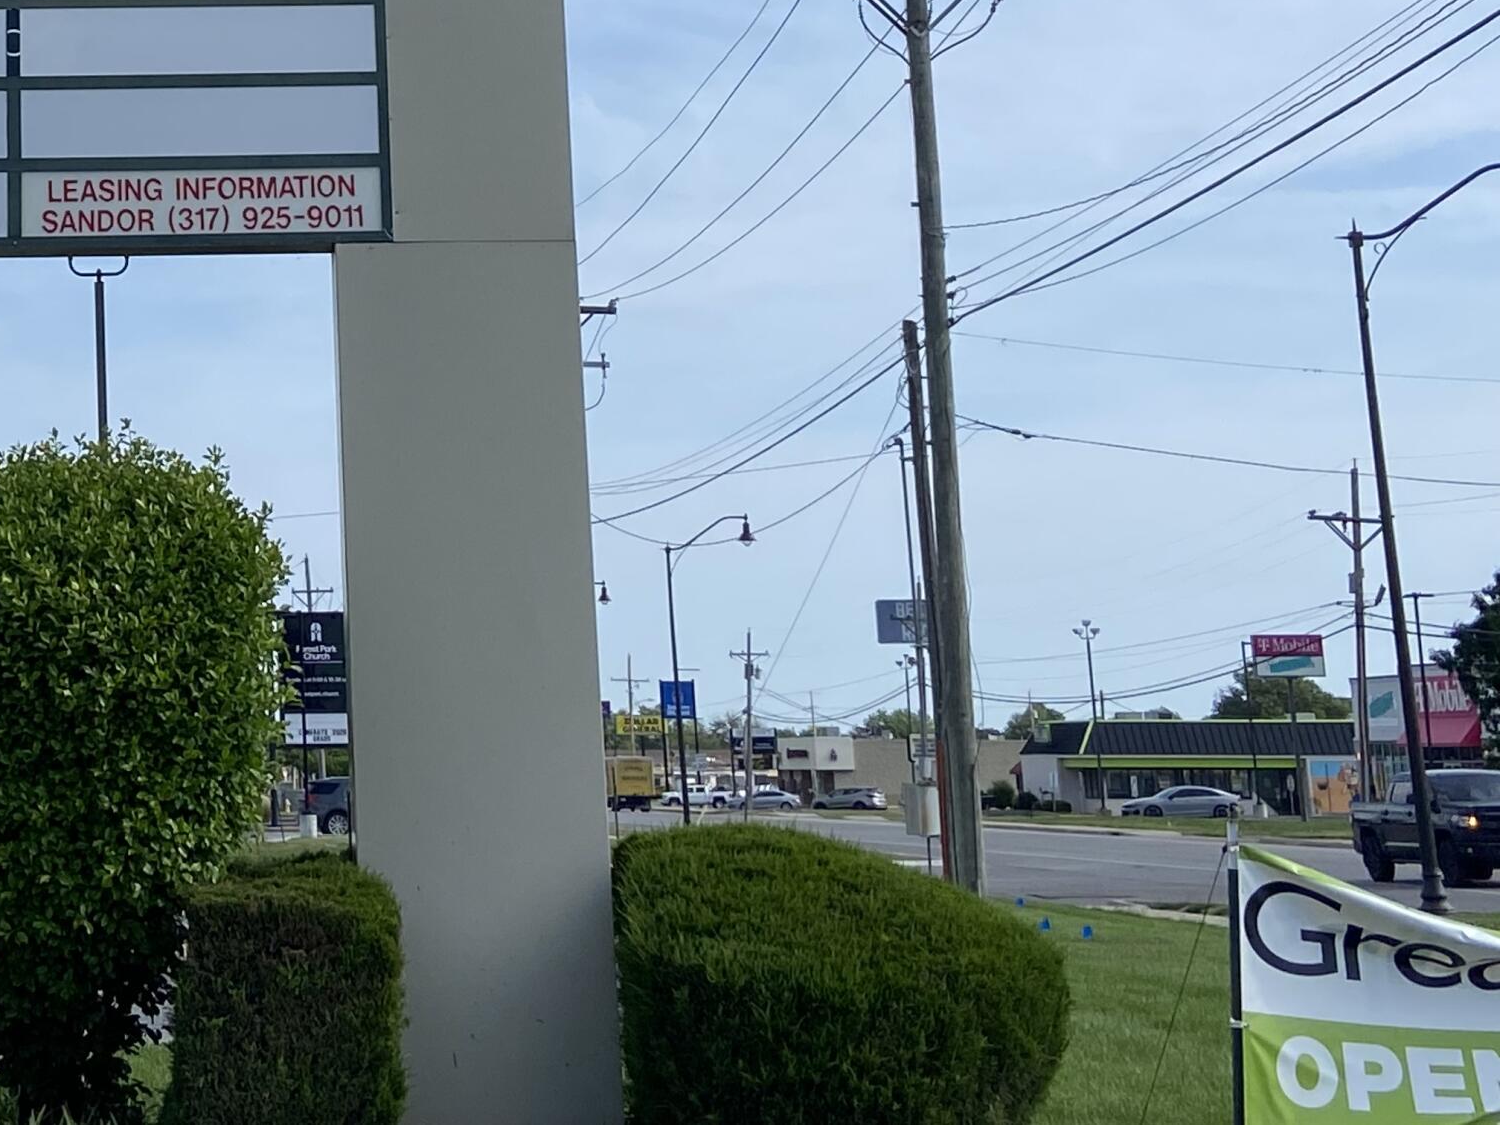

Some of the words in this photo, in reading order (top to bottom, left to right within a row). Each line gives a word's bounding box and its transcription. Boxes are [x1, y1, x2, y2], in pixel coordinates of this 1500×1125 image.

[47, 178, 163, 203] LEASING
[175, 174, 356, 201] INFORMATION
[41, 208, 155, 234] SANDOR
[167, 204, 230, 234] (317)
[242, 204, 364, 230] 925-9011
[303, 652, 331, 661] Church
[624, 717, 659, 725] DLLAR
